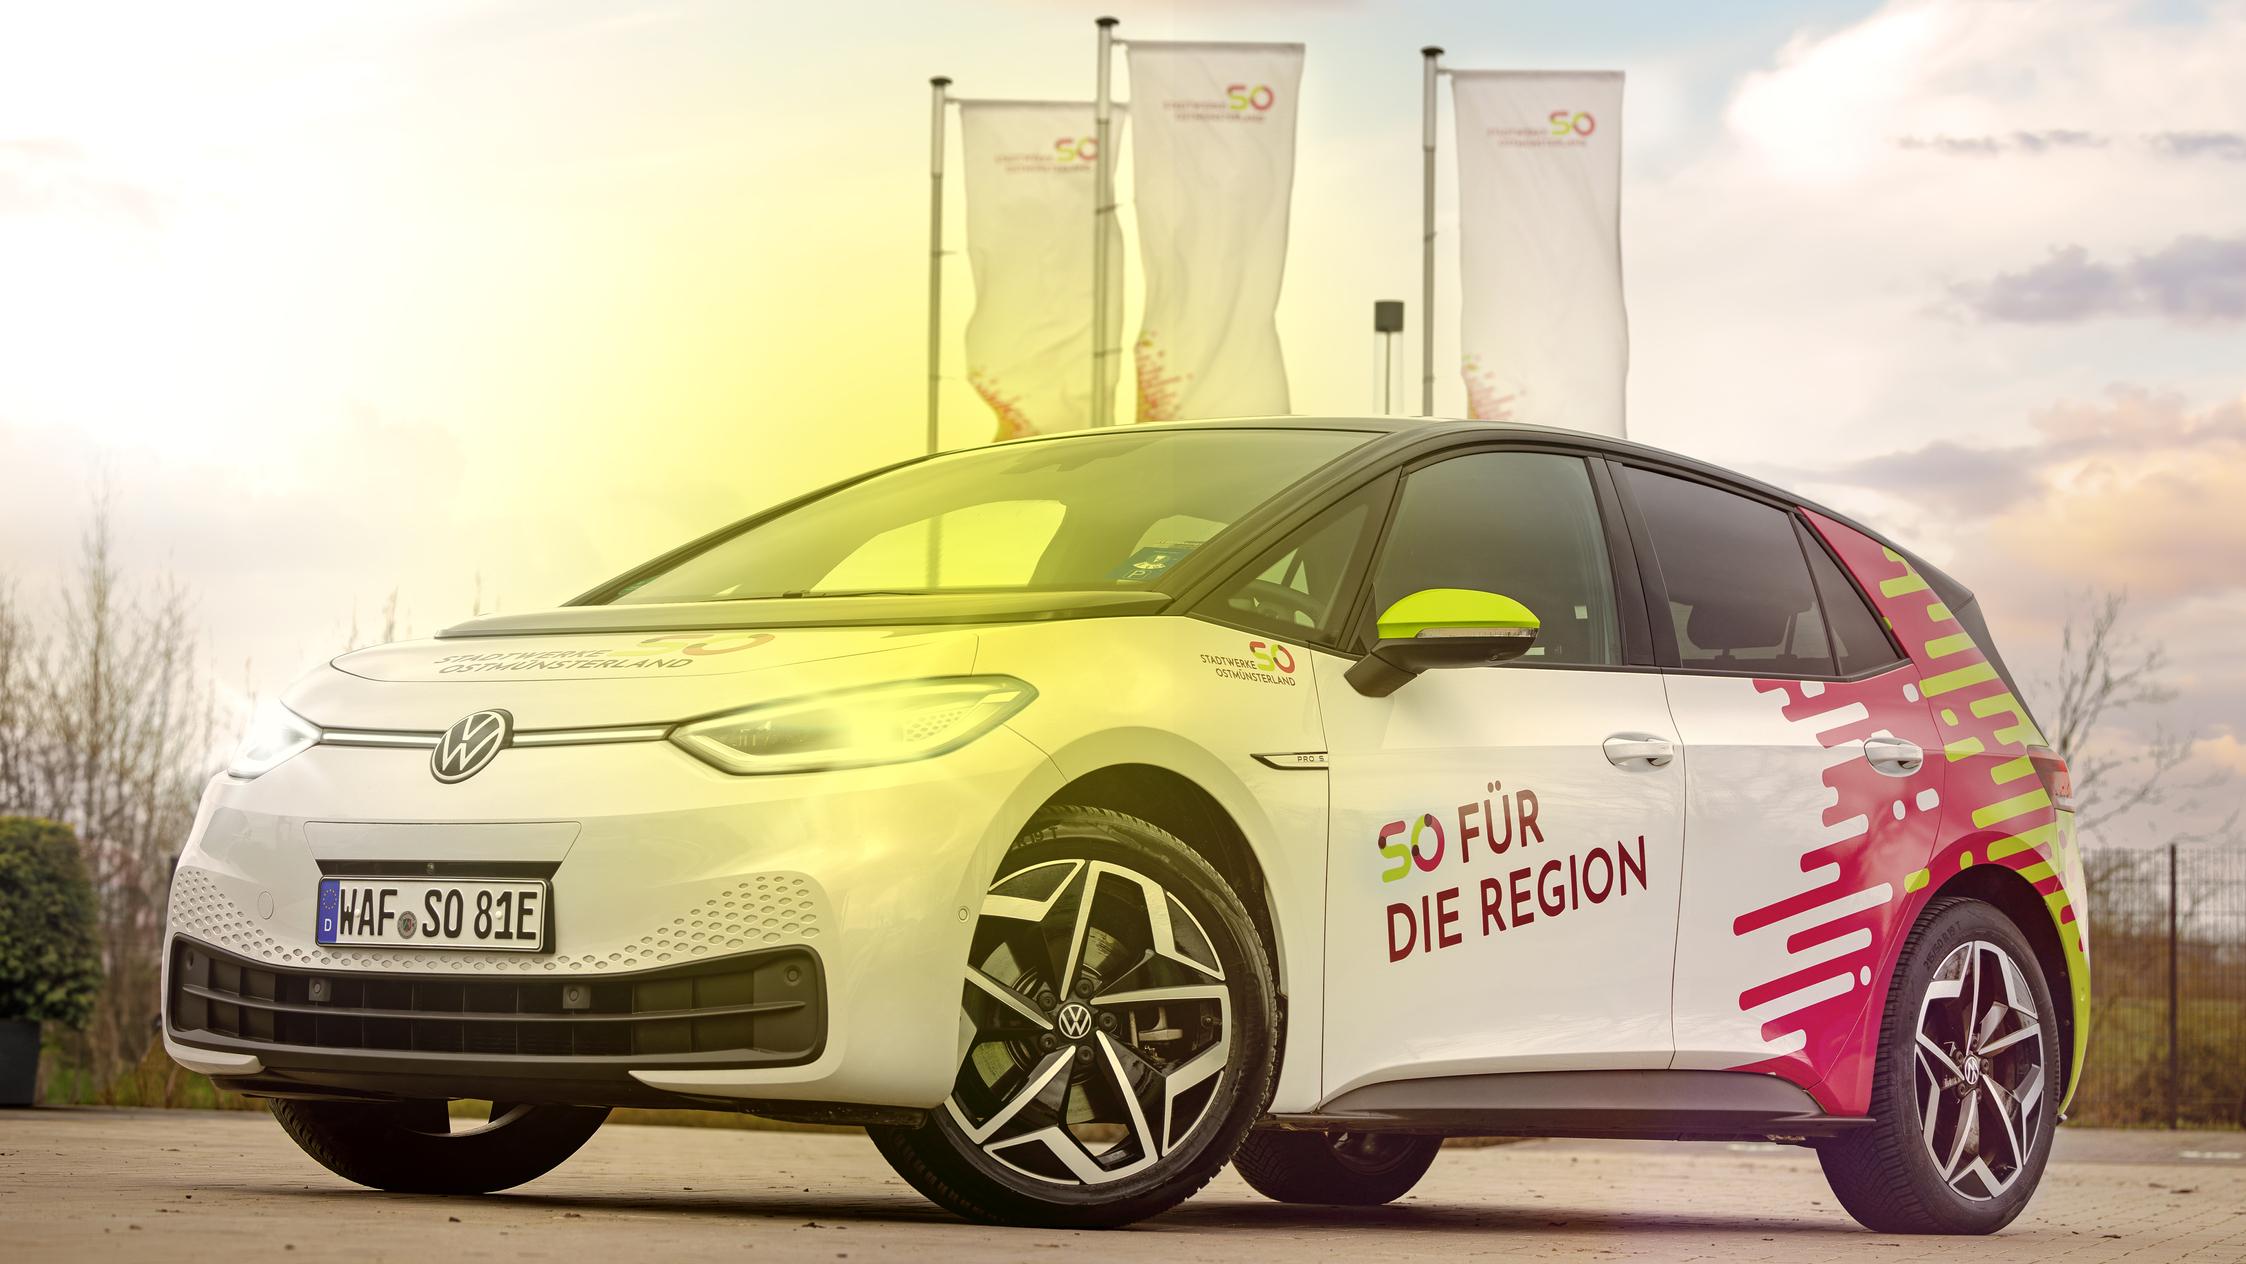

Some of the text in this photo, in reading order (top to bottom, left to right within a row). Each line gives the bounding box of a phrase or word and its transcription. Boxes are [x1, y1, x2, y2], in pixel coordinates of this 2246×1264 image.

[1226, 83, 1275, 112] SO
[1549, 111, 1596, 137] SO
[1054, 136, 1099, 163] SO
[433, 633, 776, 664] STADTWERKE SO
[1200, 641, 1296, 673] STADTWERKE SO
[438, 658, 693, 674] OSTMÜNSTERLAND
[1215, 668, 1296, 686] OSTMÜNSTERLAND
[1378, 780, 1544, 883] SO FÜR
[1386, 835, 1647, 963] DIE REGION
[324, 918, 332, 932] D
[339, 888, 398, 936] WAF
[421, 888, 464, 939] SO
[473, 889, 538, 940] 81E
